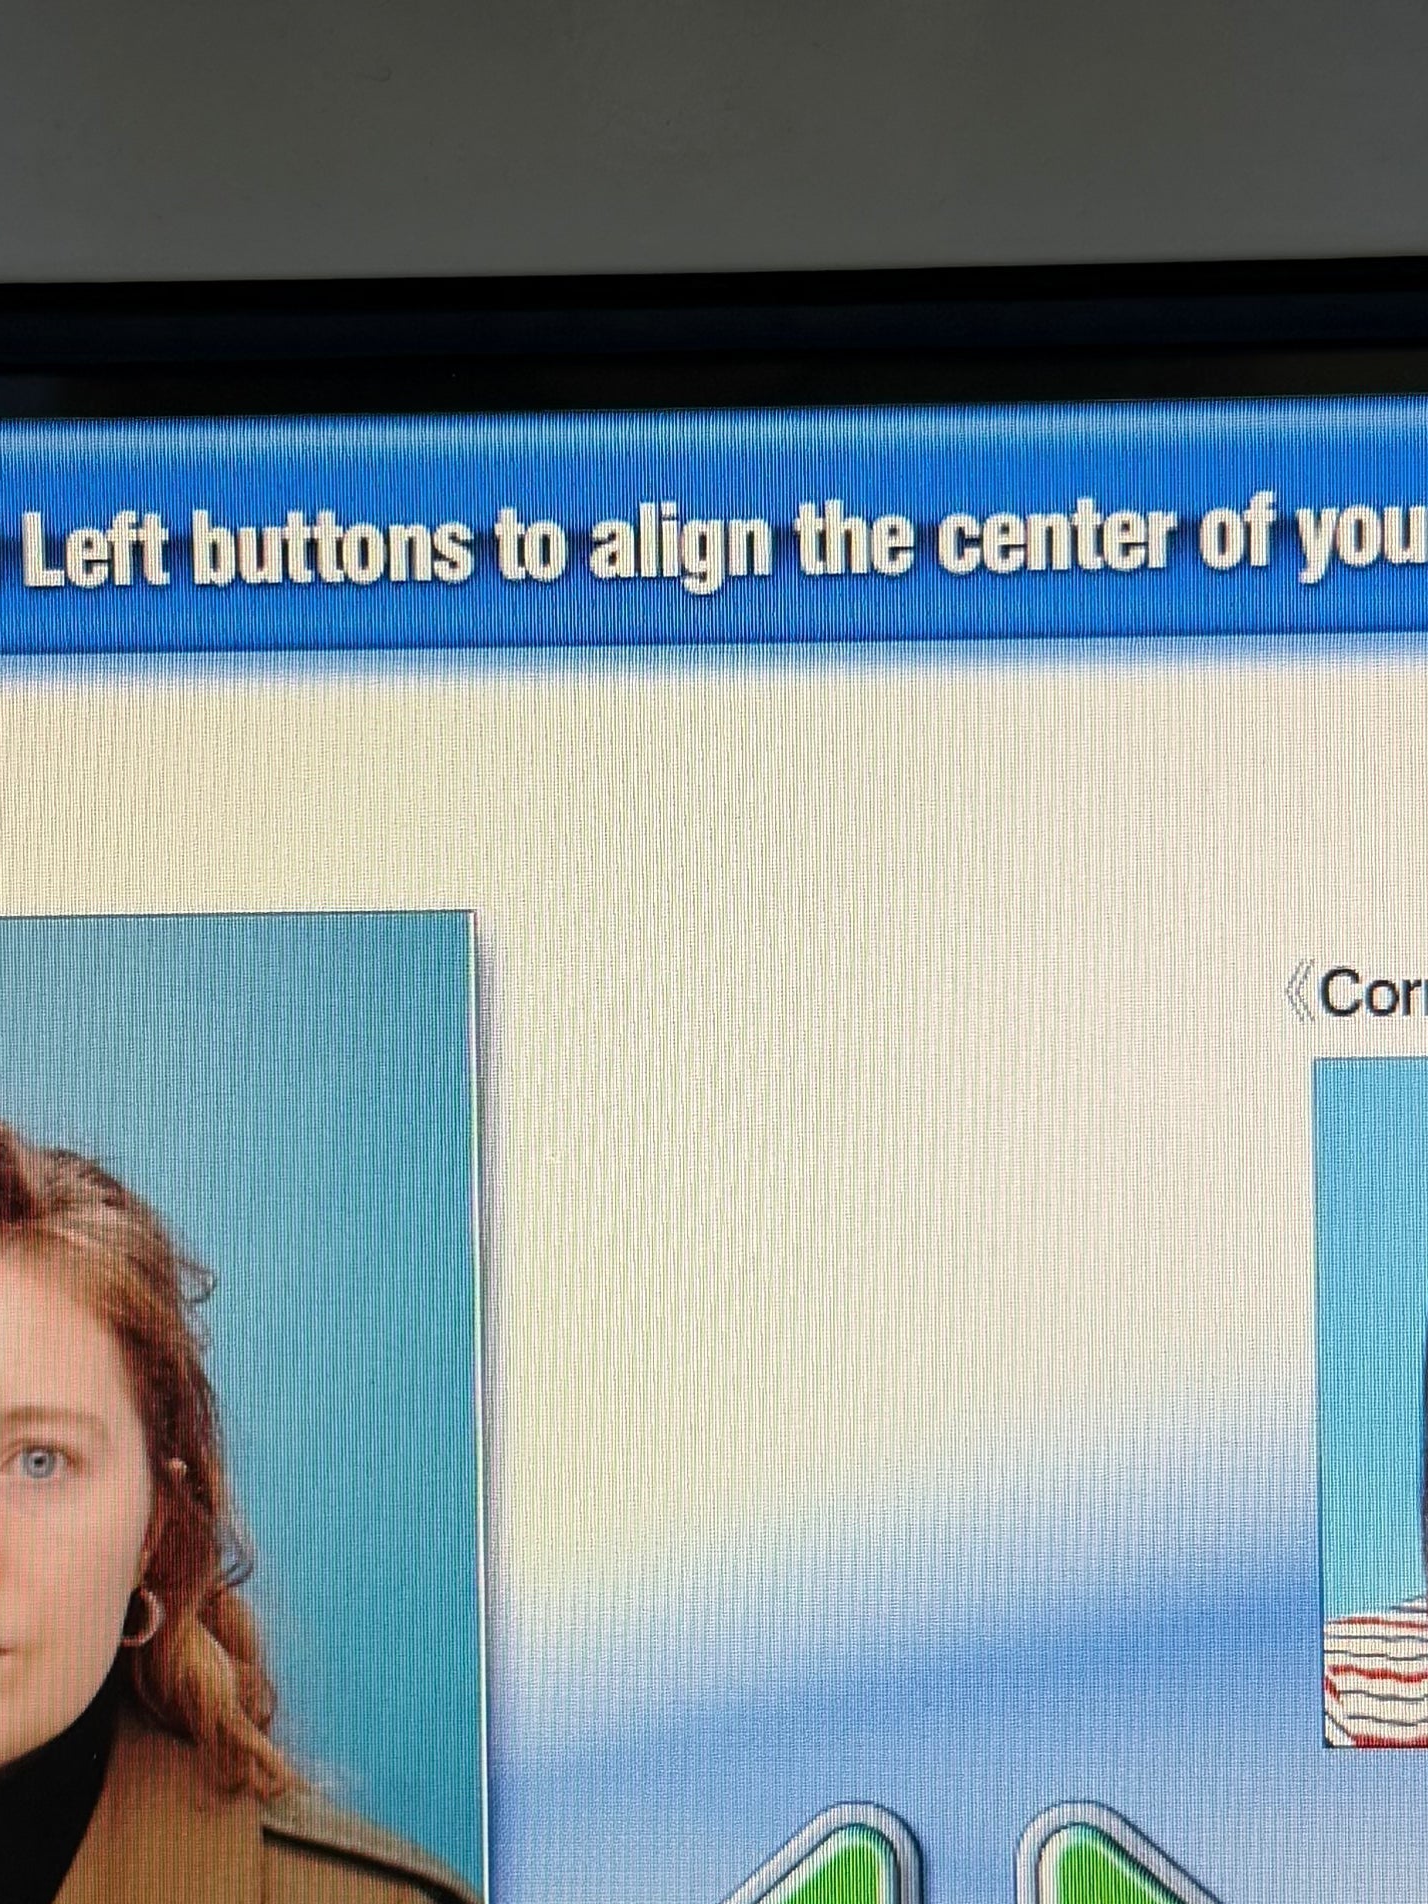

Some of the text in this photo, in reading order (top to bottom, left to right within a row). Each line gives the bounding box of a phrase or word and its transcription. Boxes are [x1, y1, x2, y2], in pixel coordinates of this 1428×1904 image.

[21, 510, 170, 588] Left
[192, 509, 474, 586] buttons
[494, 506, 567, 581] to
[589, 501, 773, 595] align
[794, 498, 915, 577] the
[938, 497, 1178, 575] center
[1200, 490, 1277, 570] of
